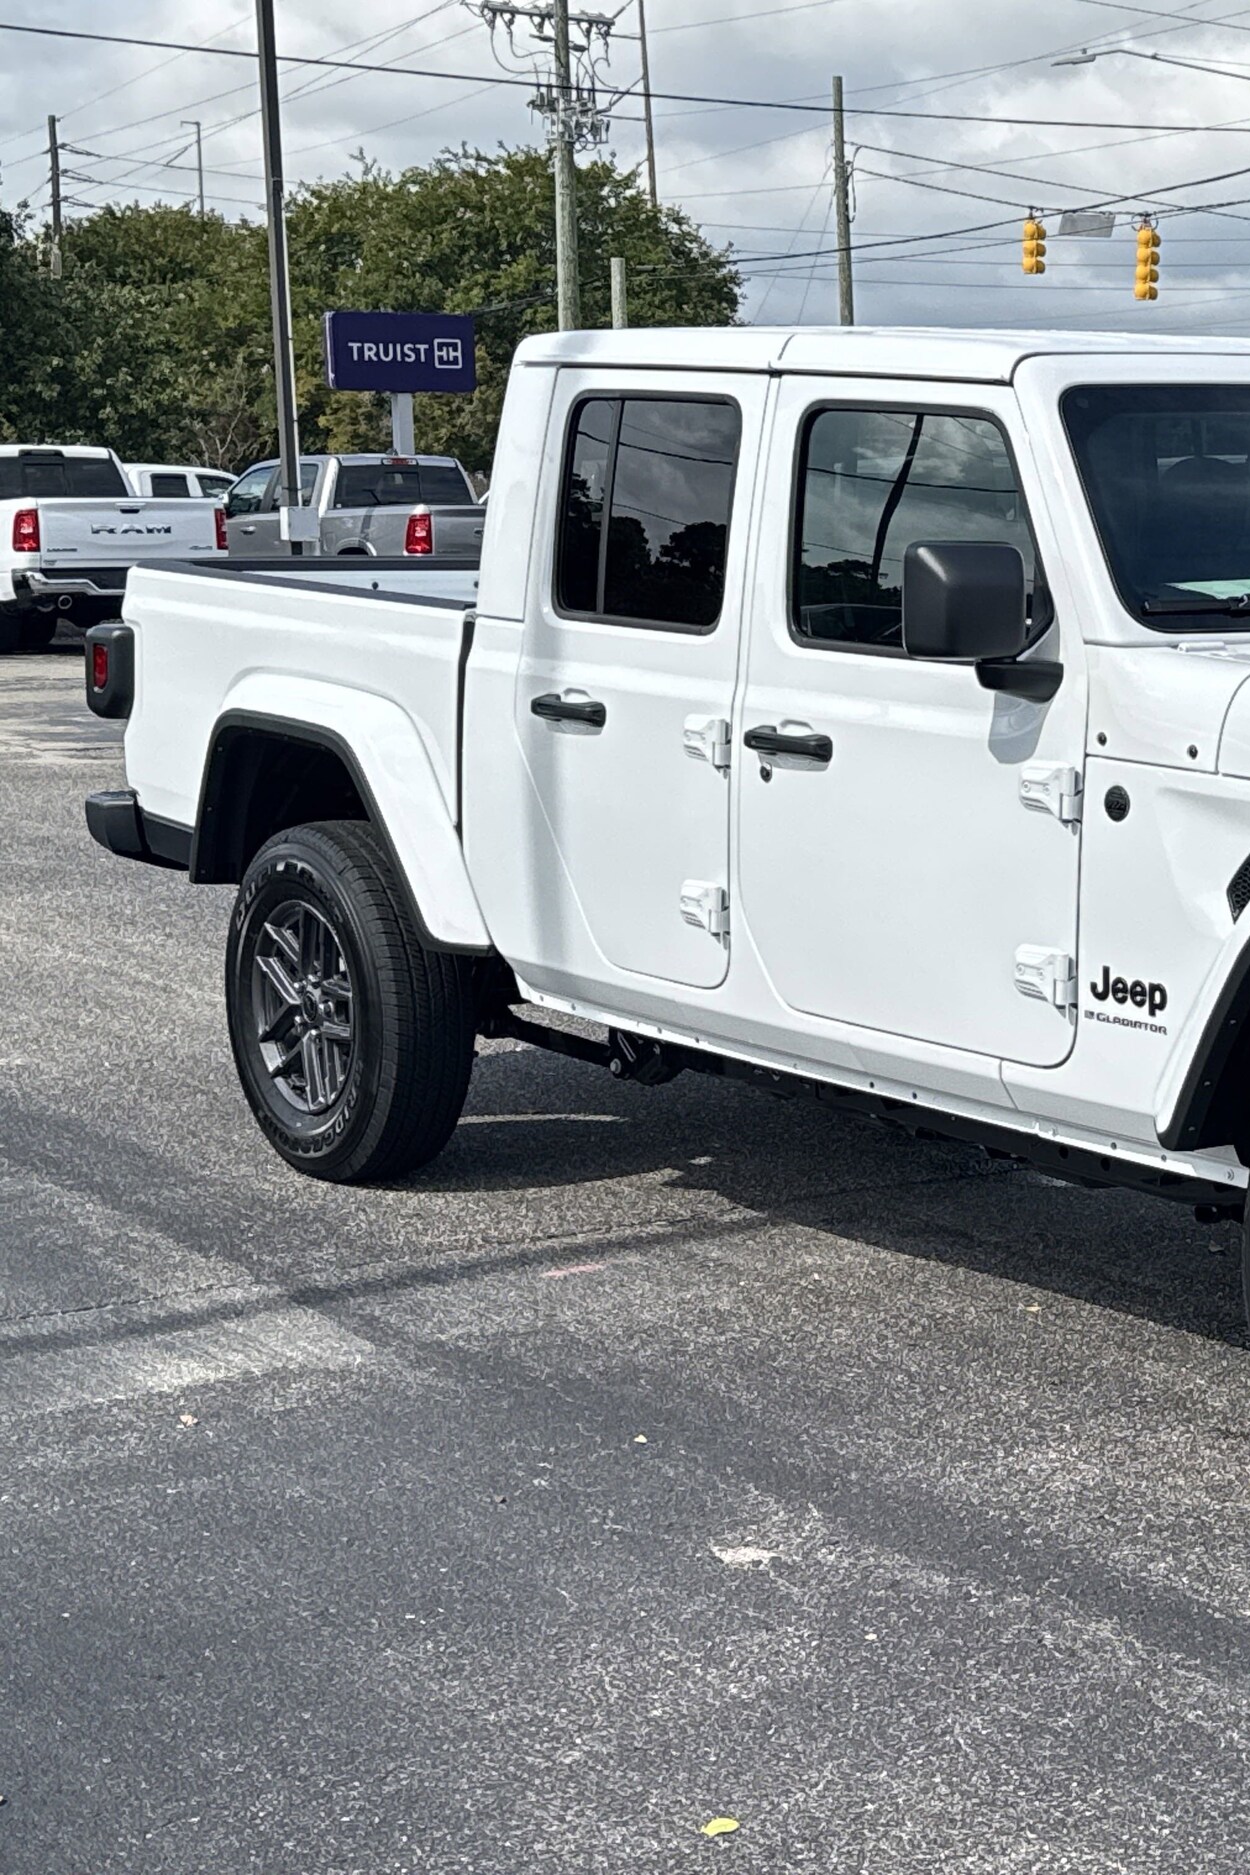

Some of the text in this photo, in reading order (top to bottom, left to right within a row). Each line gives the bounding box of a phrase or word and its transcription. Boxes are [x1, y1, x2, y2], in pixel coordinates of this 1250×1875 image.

[347, 341, 430, 363] TRUIST
[90, 523, 172, 535] RAM
[1089, 964, 1168, 1018] Jeep
[1095, 1011, 1168, 1036] GLADIATOR
